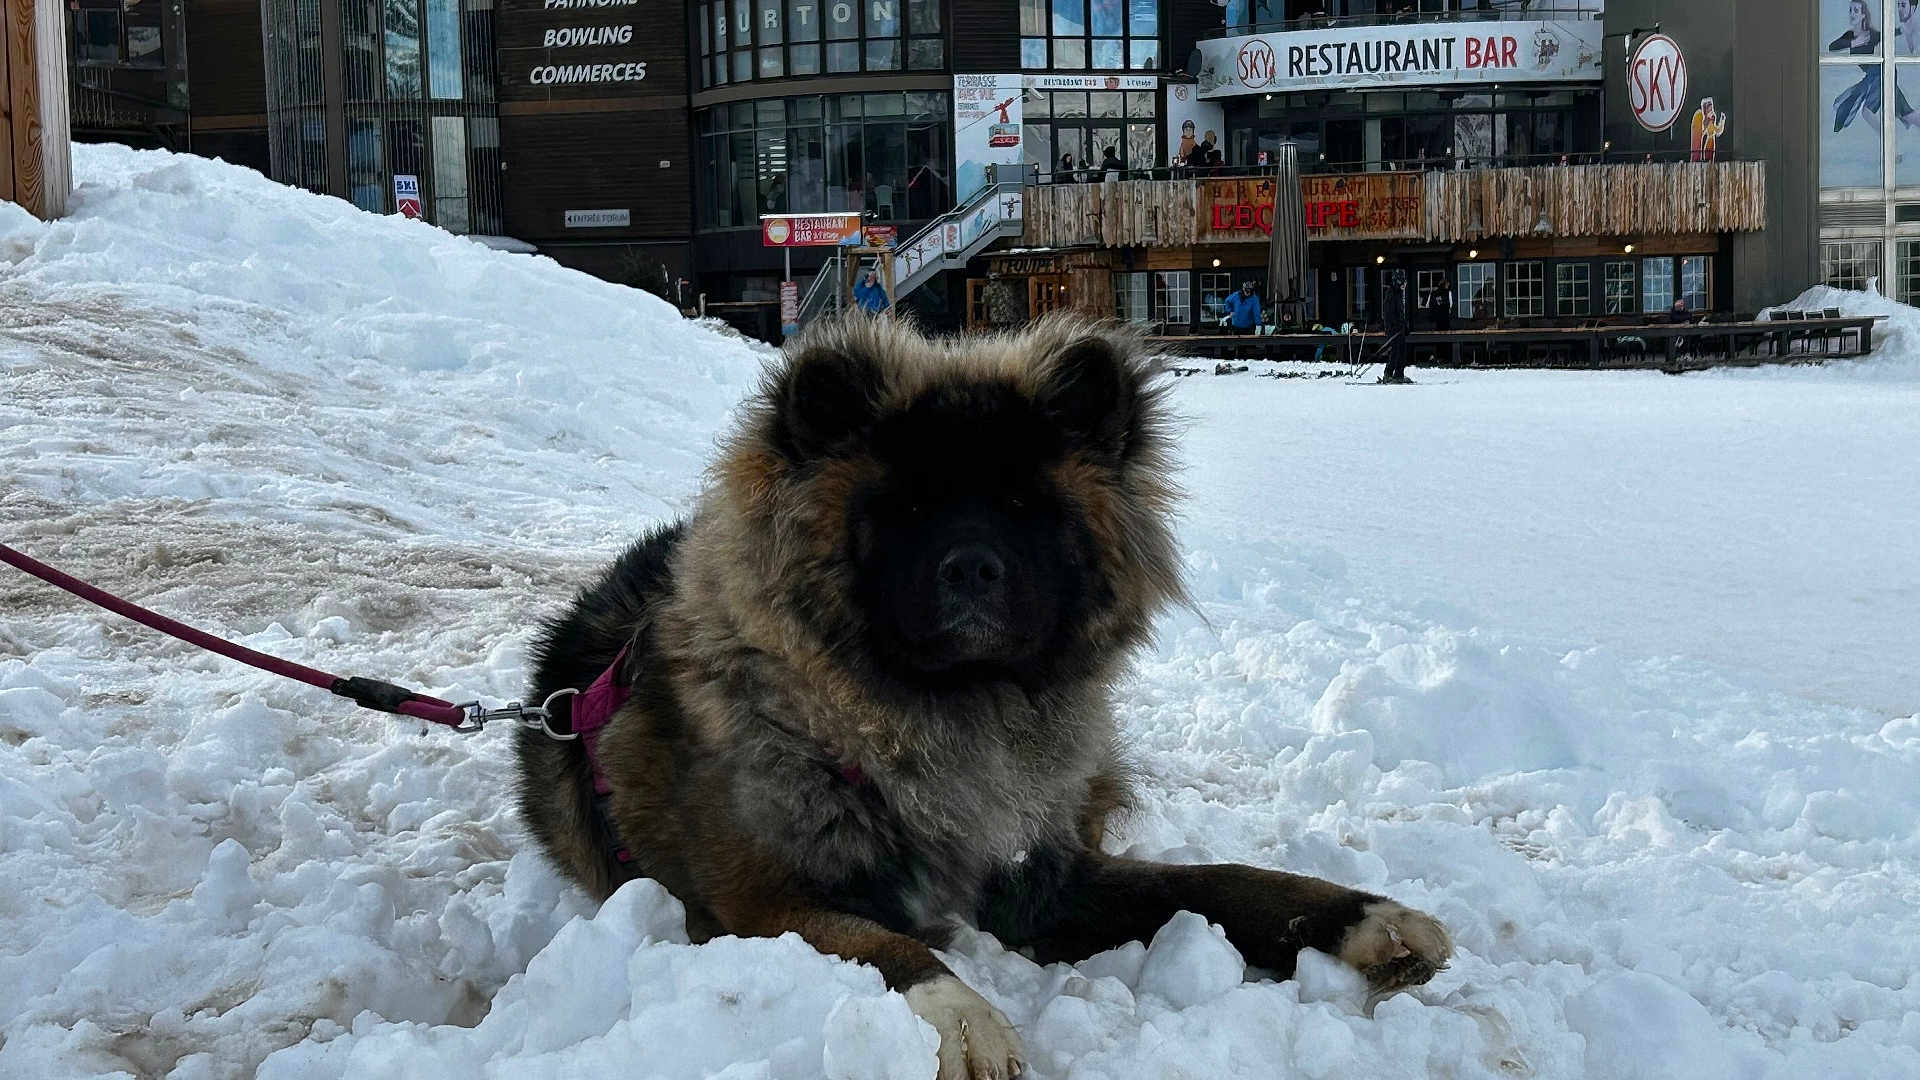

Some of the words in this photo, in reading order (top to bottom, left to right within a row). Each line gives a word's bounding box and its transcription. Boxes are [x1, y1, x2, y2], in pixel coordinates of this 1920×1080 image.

[718, 1, 892, 36] BURTON
[543, 25, 633, 48] BOWLING
[529, 62, 647, 84] COMMERCES
[1238, 49, 1274, 80] SKY
[1288, 37, 1456, 78] RESTAURANT
[1465, 36, 1518, 69] BAR
[1633, 54, 1682, 117] SKY
